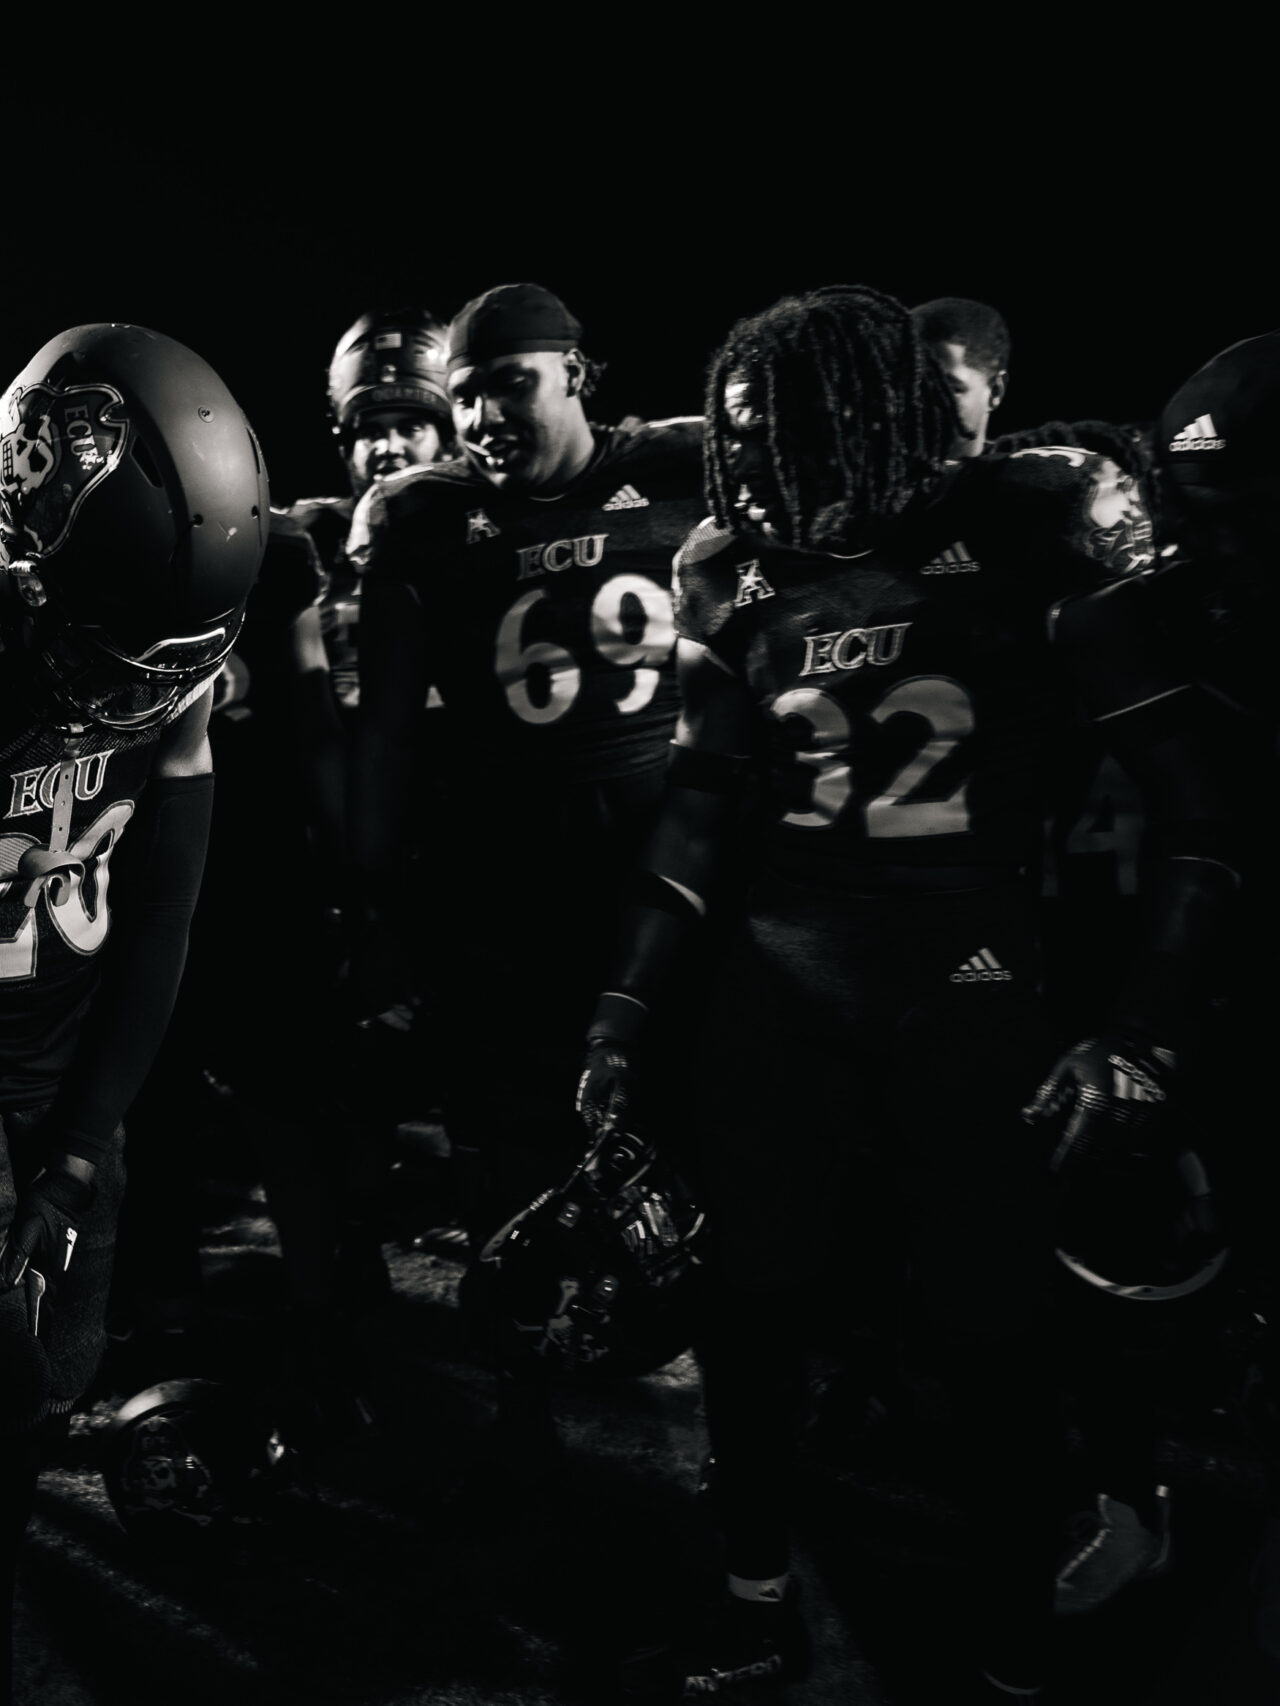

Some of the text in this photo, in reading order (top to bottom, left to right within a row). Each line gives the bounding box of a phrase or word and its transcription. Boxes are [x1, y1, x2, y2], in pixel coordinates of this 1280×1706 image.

[64, 404, 99, 458] ECU
[1168, 438, 1227, 452] adidas
[515, 533, 610, 581] ECU
[919, 560, 981, 576] adidas
[493, 572, 678, 725] 69
[798, 622, 914, 677] ECU
[769, 674, 975, 839] 32
[948, 969, 1014, 983] adidas
